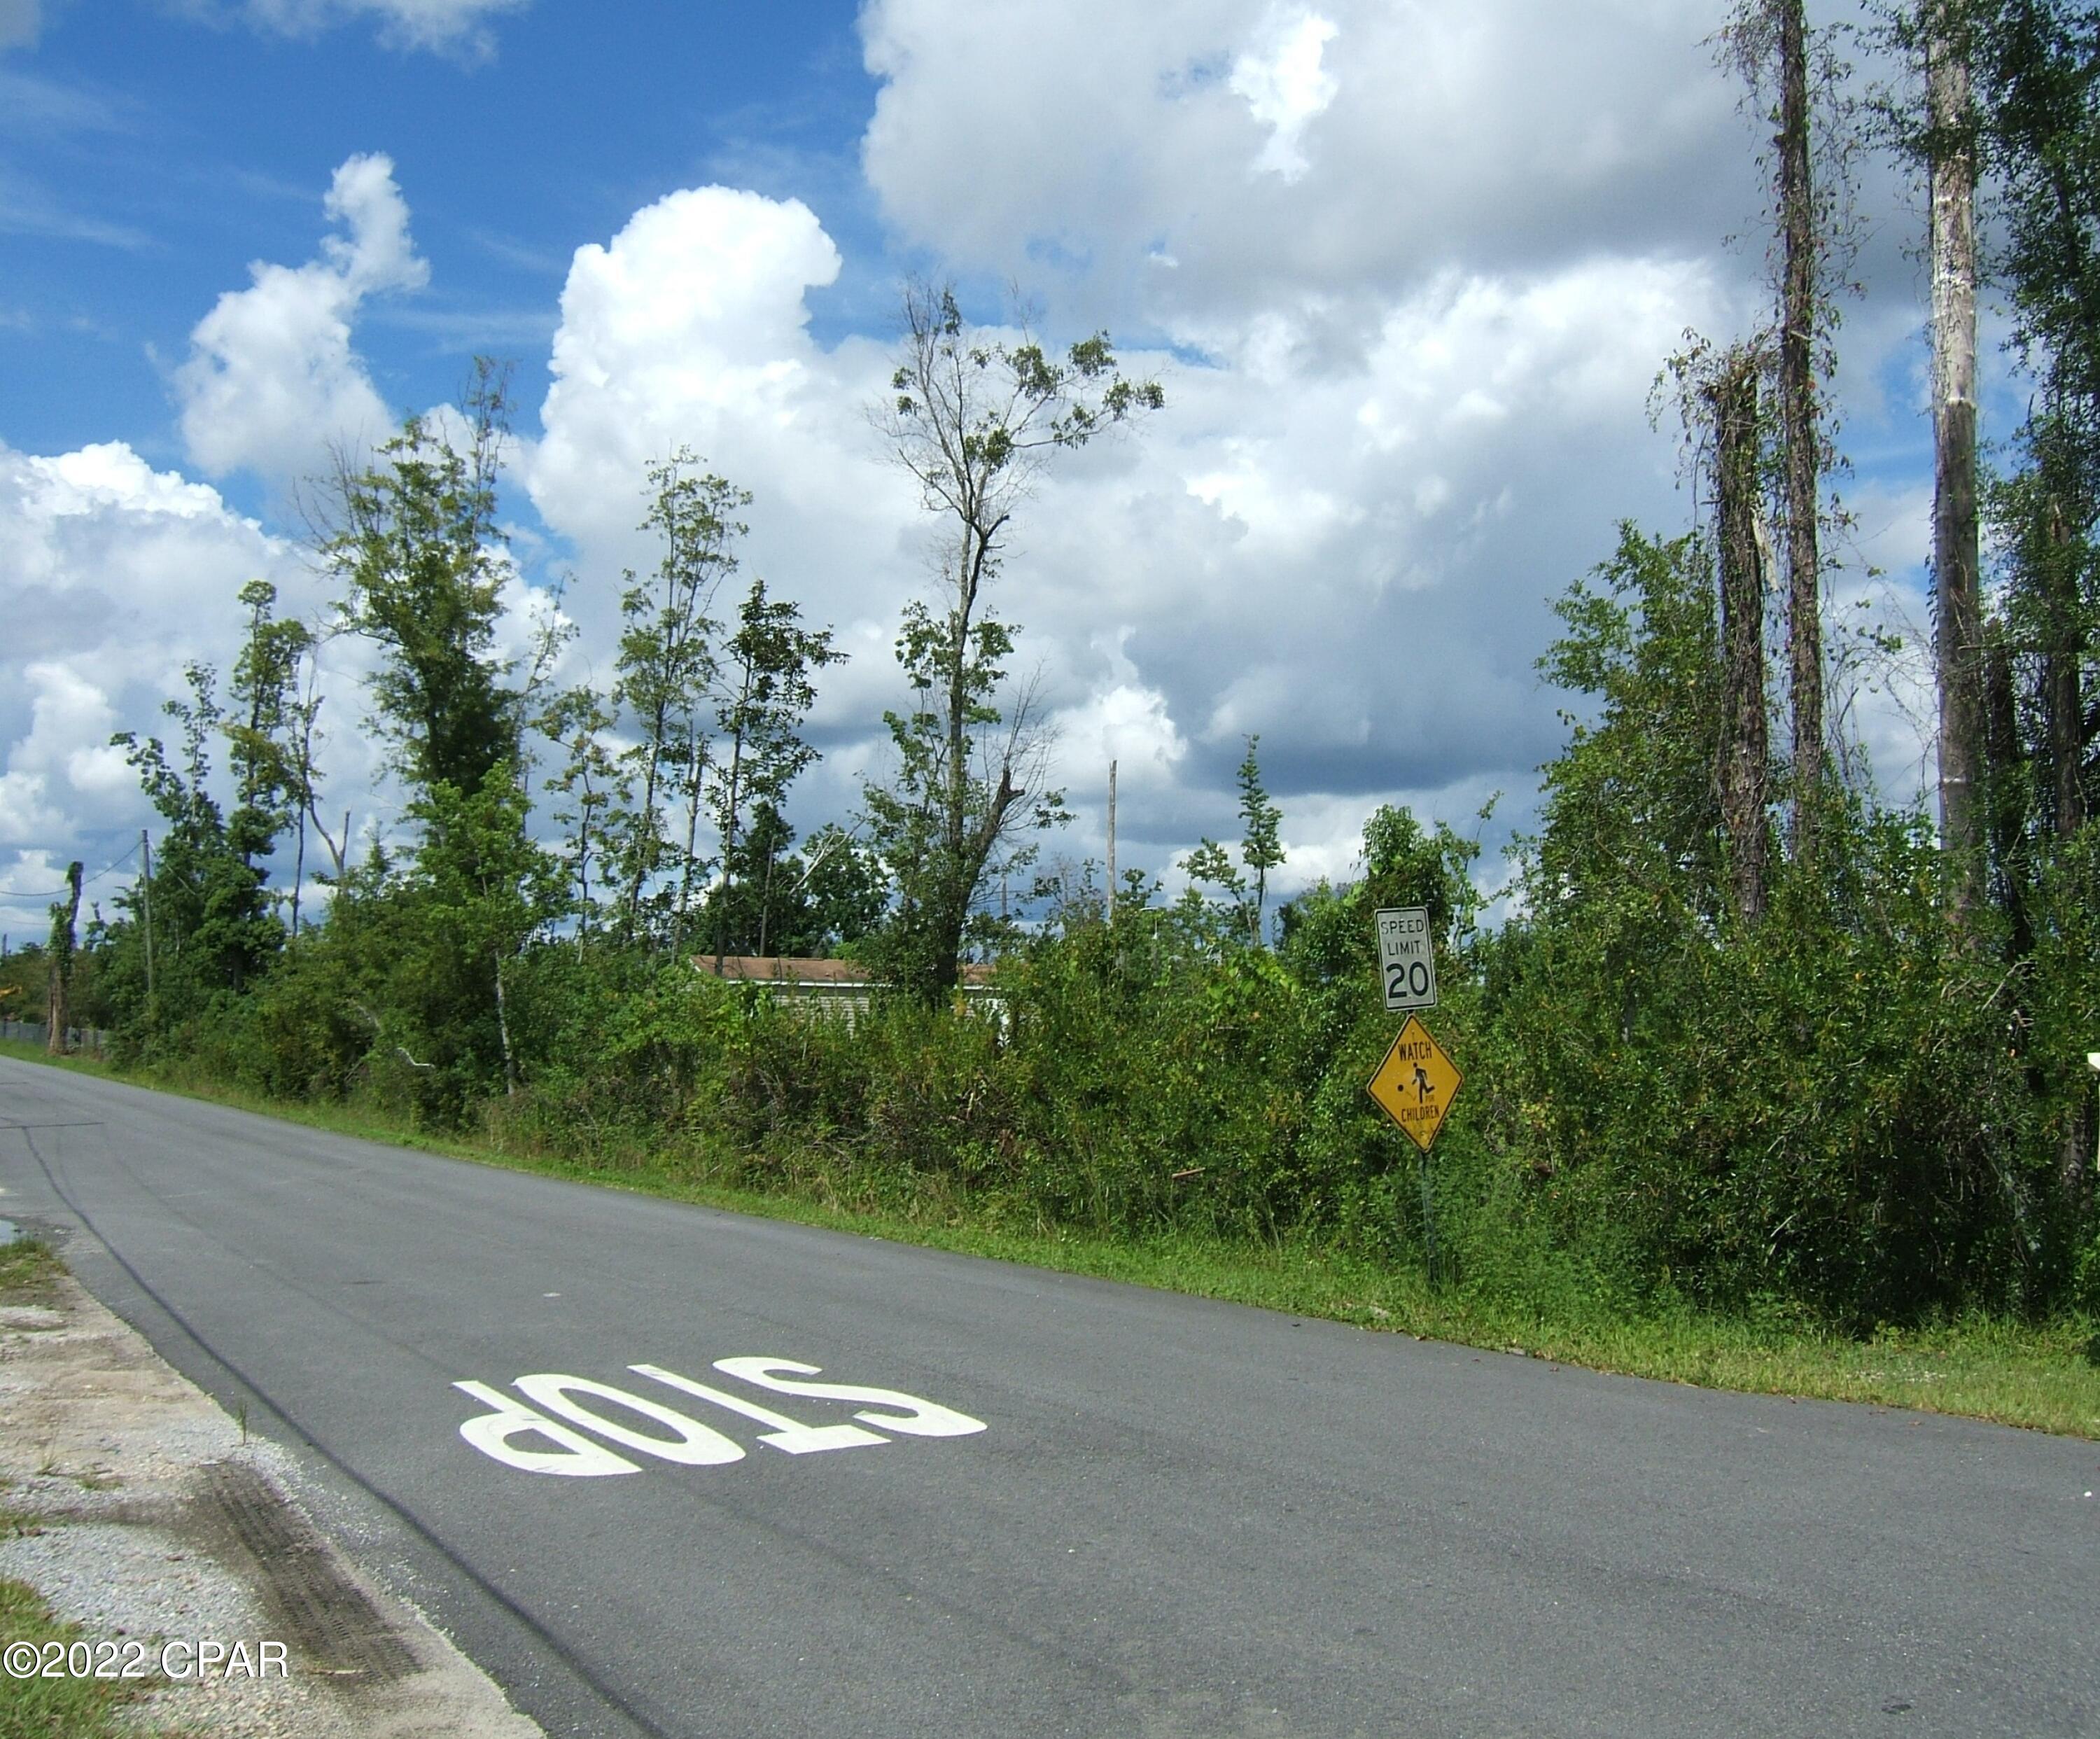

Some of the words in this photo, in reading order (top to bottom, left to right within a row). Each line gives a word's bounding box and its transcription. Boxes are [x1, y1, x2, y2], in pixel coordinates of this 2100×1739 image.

[1380, 919, 1424, 935] SPEED
[1387, 940, 1420, 956] LIMIT
[1386, 961, 1429, 998] 20
[1398, 1041, 1432, 1061] WATCH
[1401, 1105, 1440, 1122] CHILDREN
[451, 1357, 988, 1476] STOP
